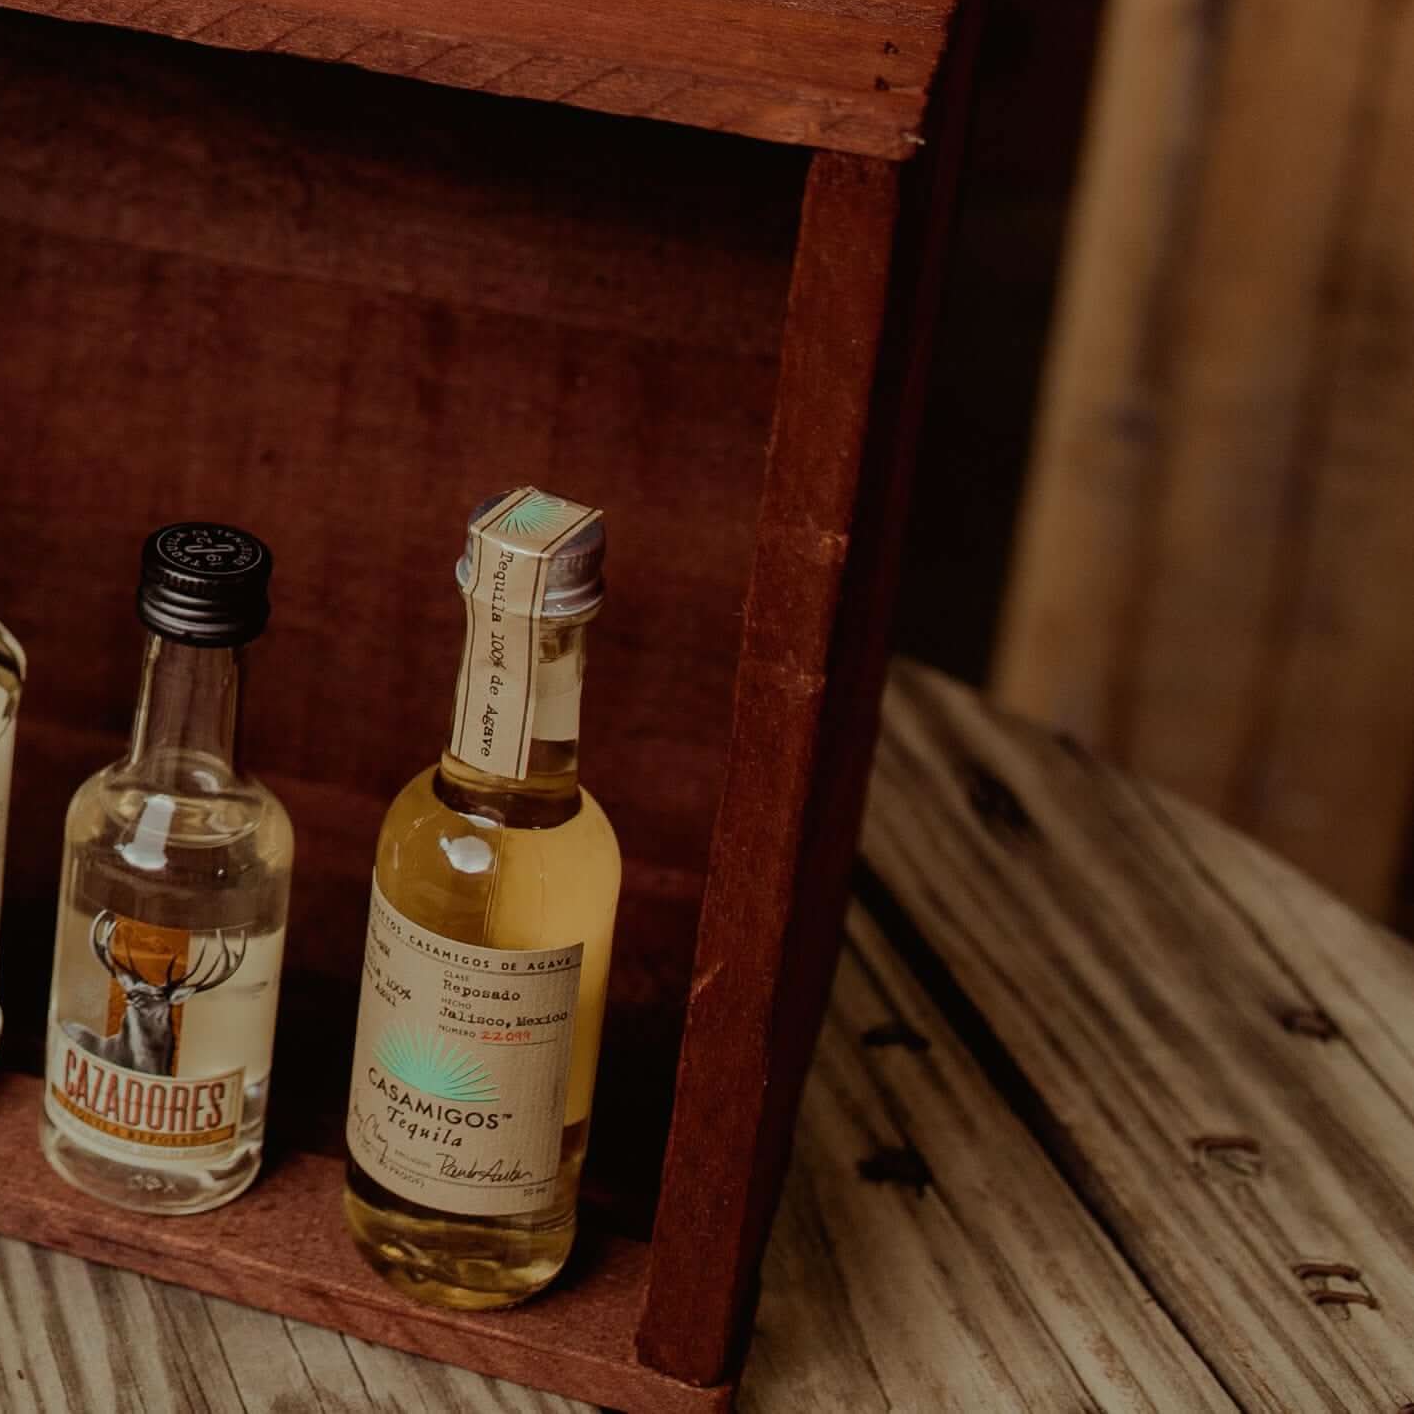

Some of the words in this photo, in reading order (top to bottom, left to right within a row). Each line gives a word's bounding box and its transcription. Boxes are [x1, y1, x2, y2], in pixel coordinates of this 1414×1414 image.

[490, 550, 515, 623] Tequila
[488, 674, 506, 697] de
[481, 703, 500, 758] Agave
[409, 935, 491, 970] CASAMIGOS
[501, 961, 518, 972] DE
[526, 954, 573, 971] AGAVE
[443, 979, 522, 1003] Reposado
[439, 1006, 512, 1030] Jalisco,
[65, 1048, 226, 1132] CAZADORES
[387, 1105, 463, 1148] Tequila
